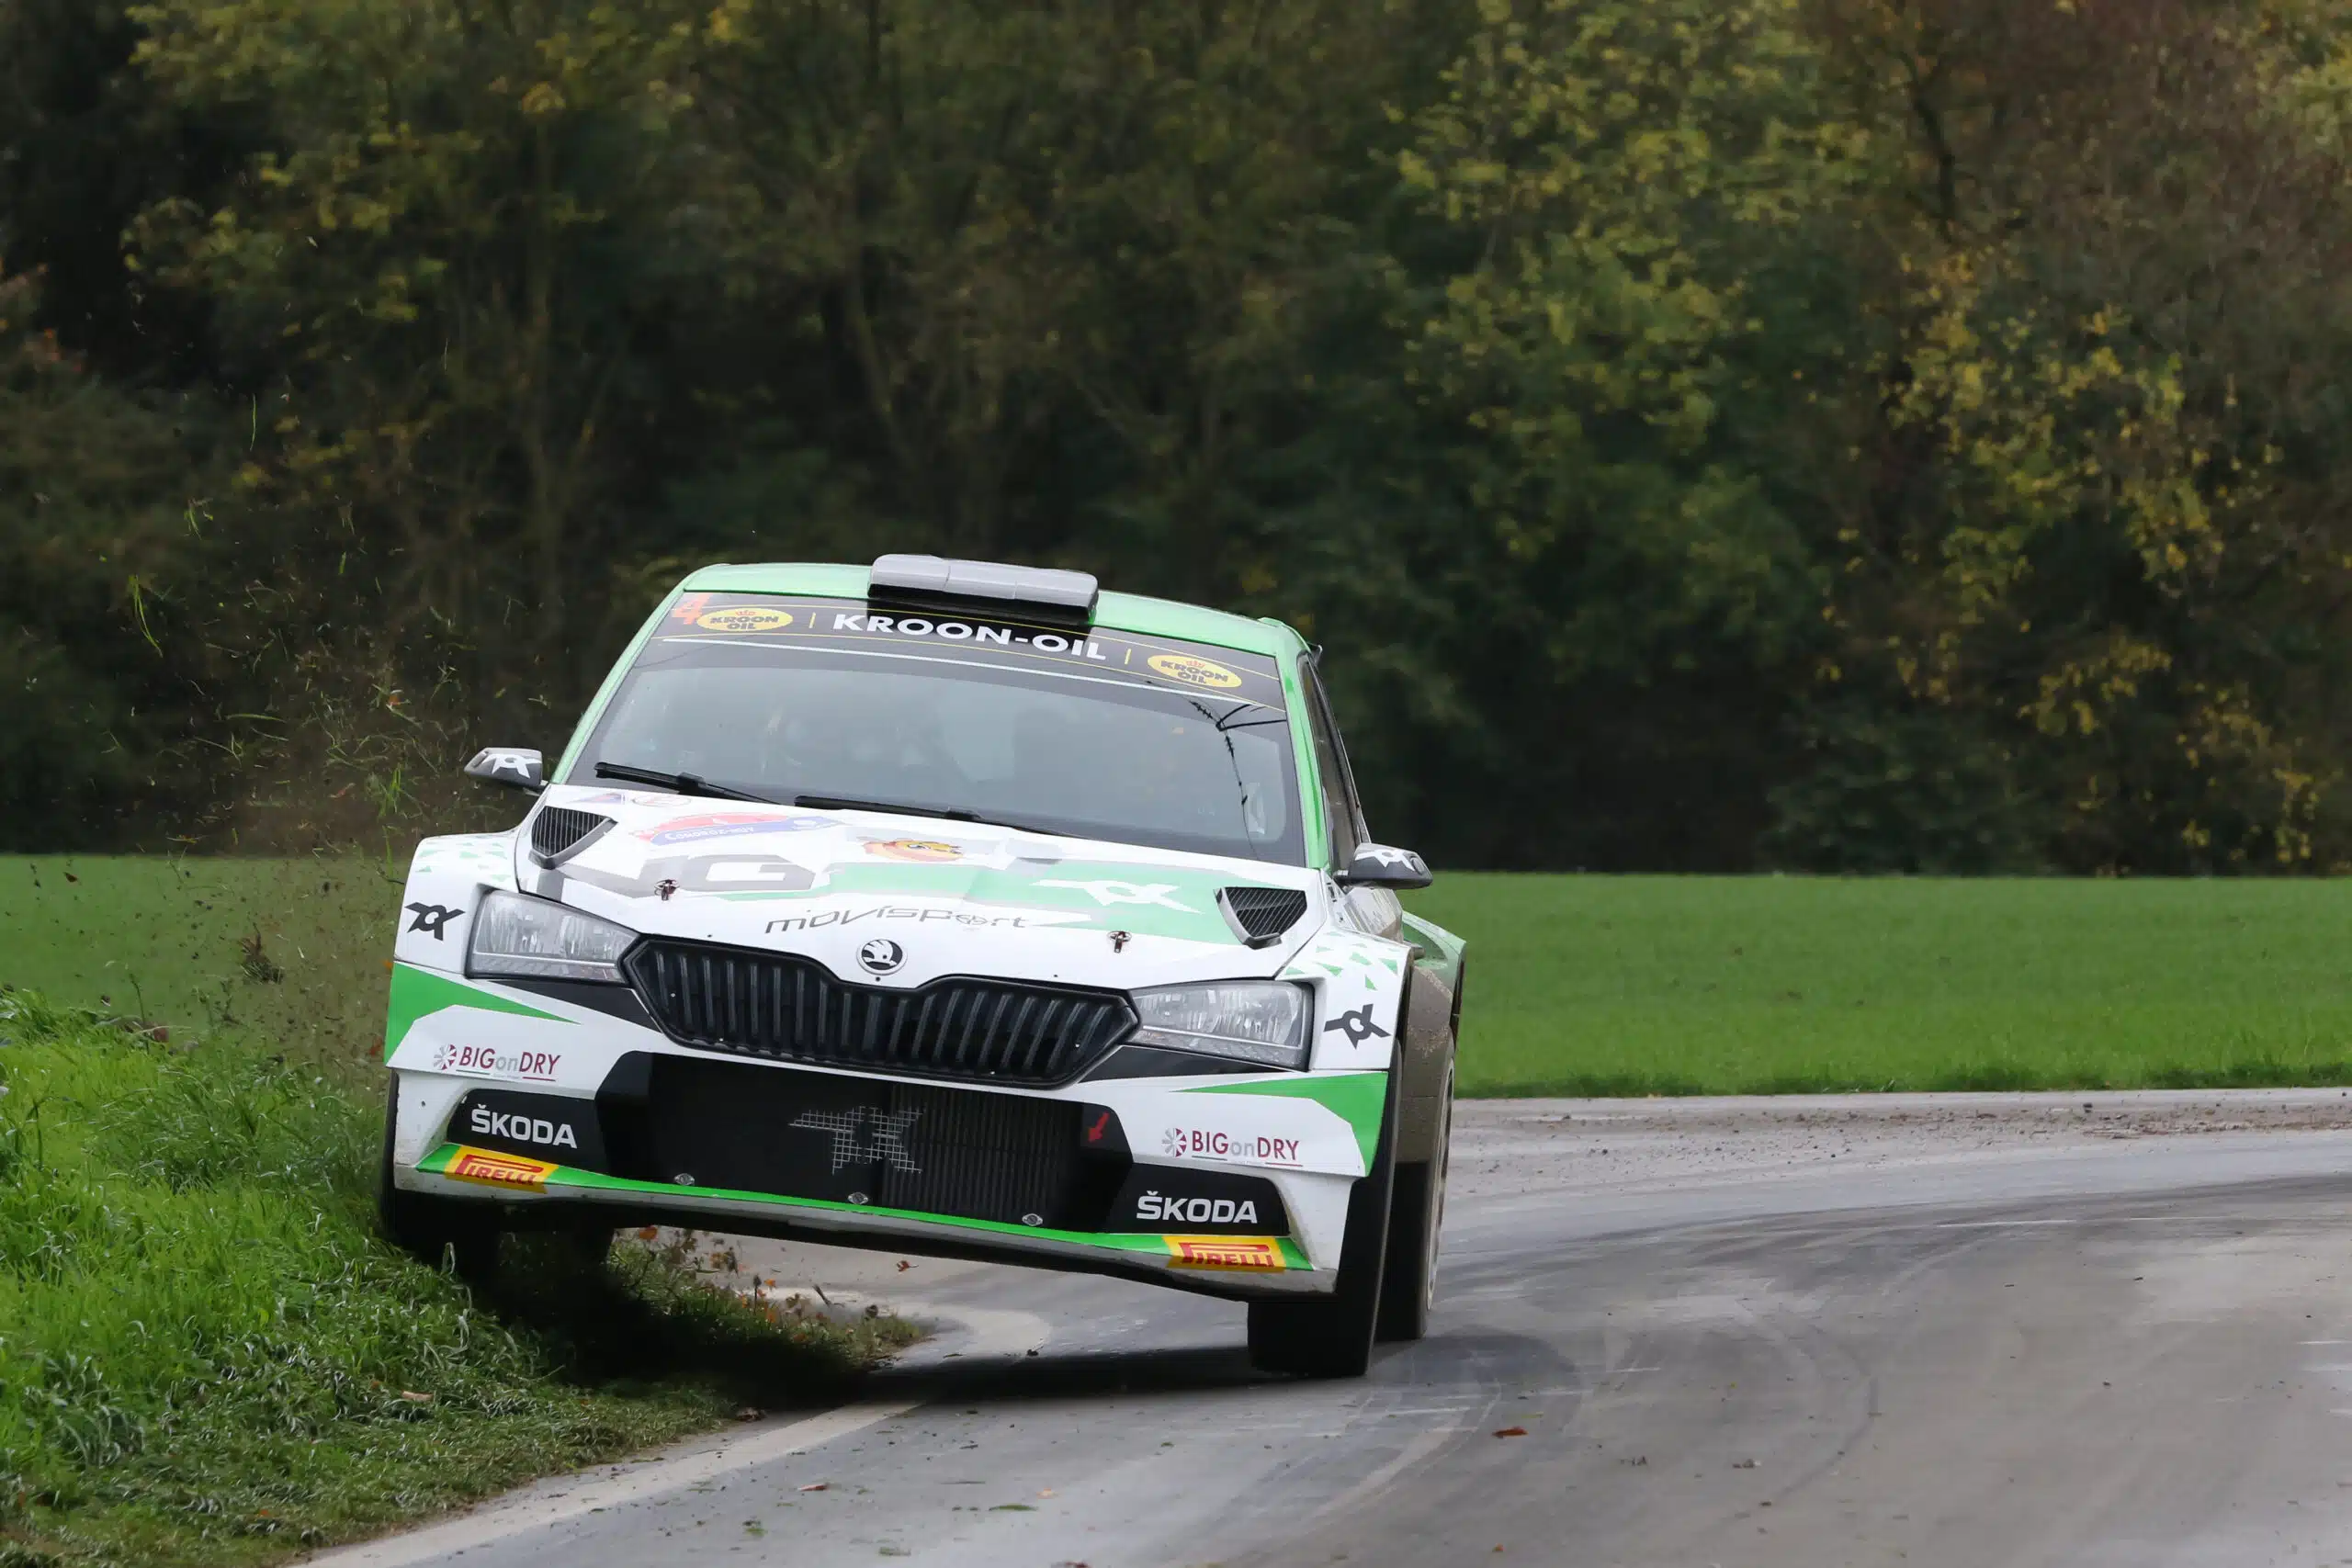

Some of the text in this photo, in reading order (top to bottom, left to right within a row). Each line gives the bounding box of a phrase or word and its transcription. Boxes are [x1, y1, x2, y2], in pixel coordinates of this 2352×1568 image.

[710, 615, 778, 624] KROON
[833, 614, 1106, 660] KROON-OIL
[1160, 660, 1229, 682] KROON
[1177, 671, 1206, 684] OIL
[458, 1045, 561, 1075] BIGonDRY
[470, 1103, 578, 1149] ŠKODA
[1191, 1130, 1300, 1161] BIGonDRY
[455, 1154, 545, 1186] PIRELLI
[1136, 1190, 1259, 1224] ŠKODA
[1178, 1241, 1275, 1269] PIRELLI
